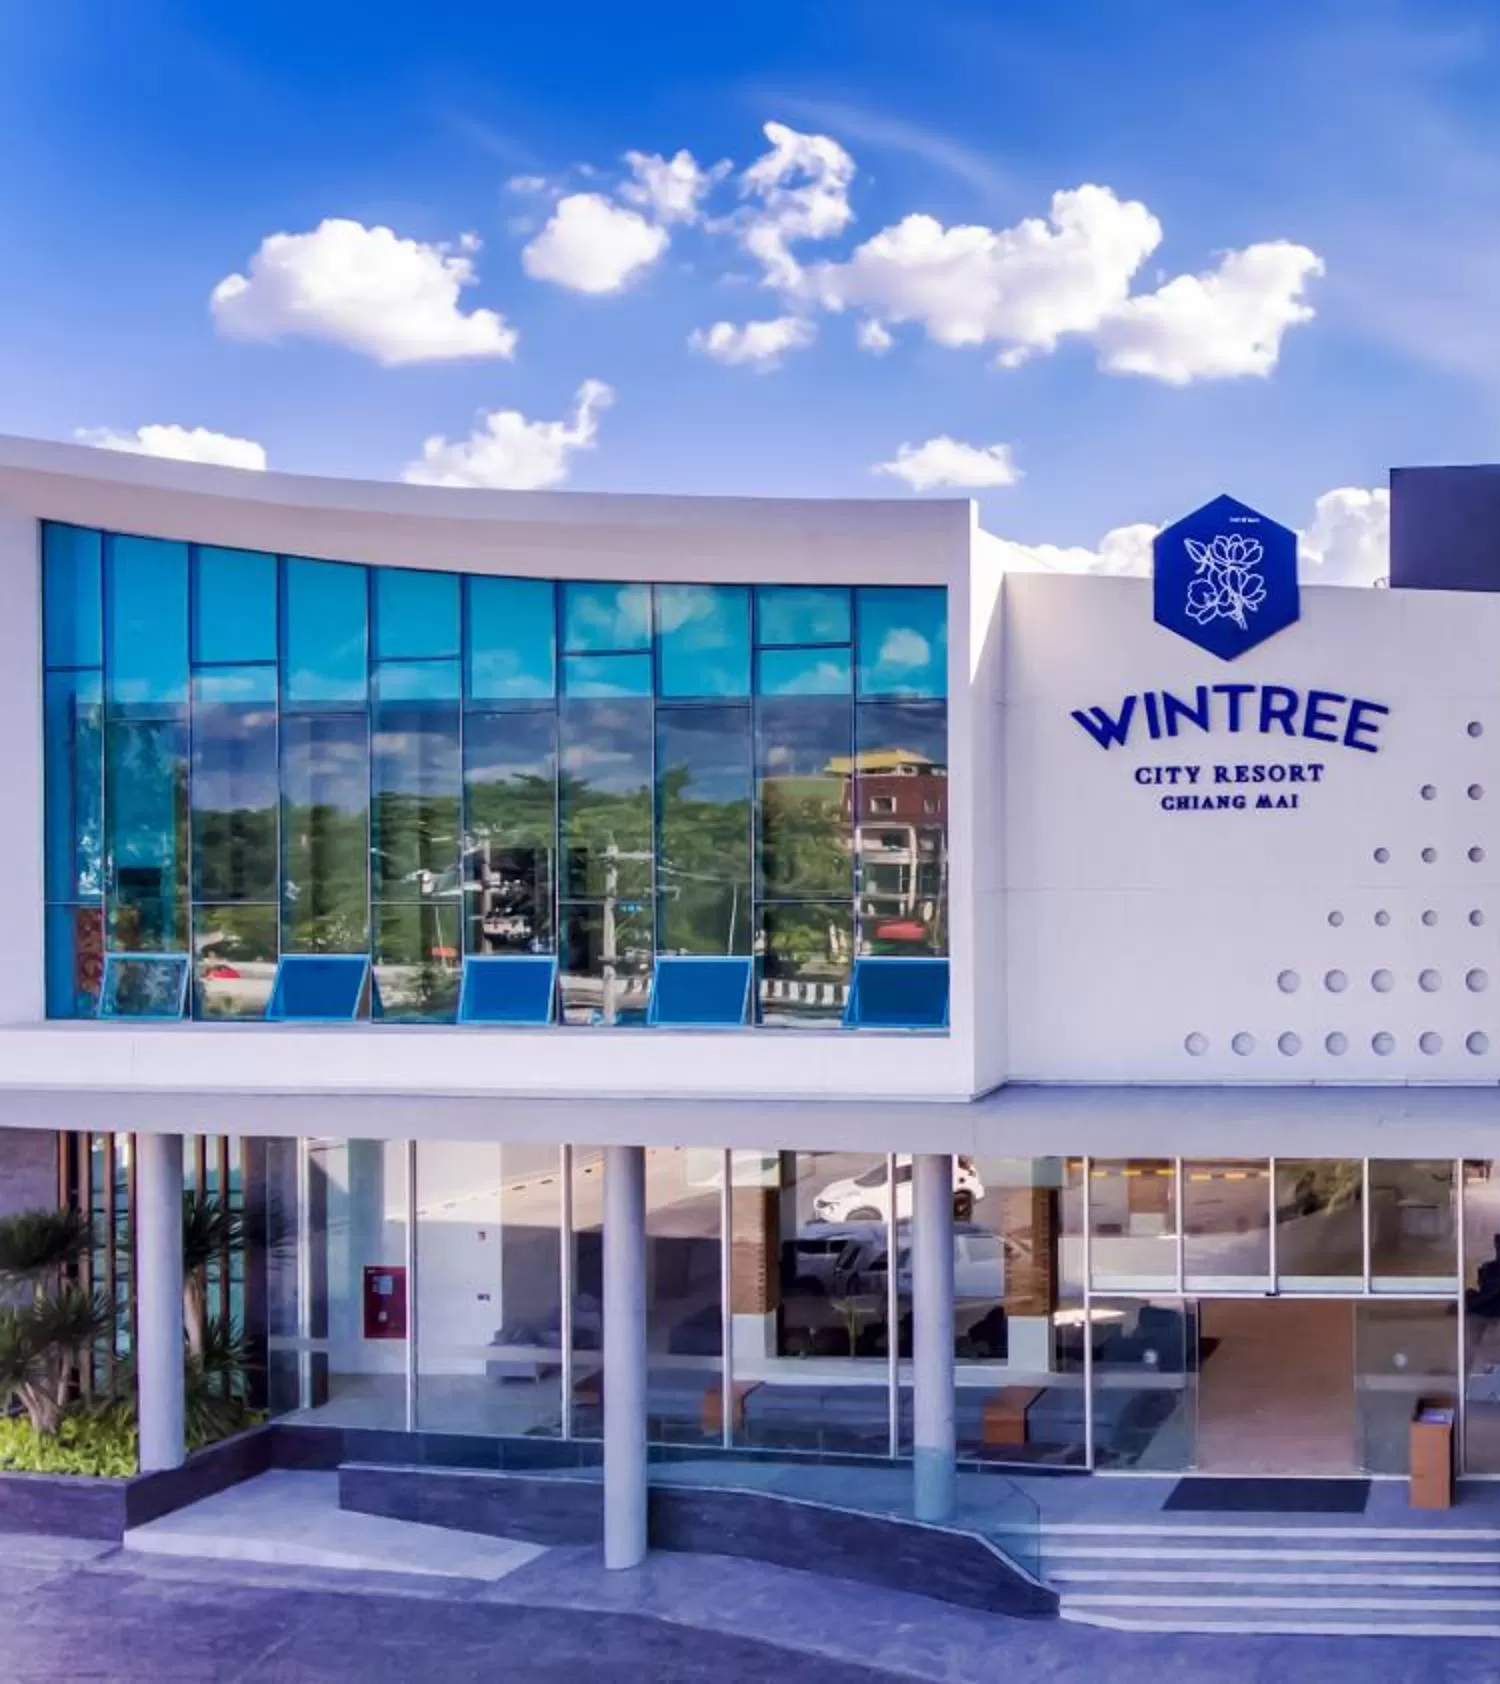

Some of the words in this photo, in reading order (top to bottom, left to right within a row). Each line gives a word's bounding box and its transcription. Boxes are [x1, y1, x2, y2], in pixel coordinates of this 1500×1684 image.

[1070, 683, 1390, 754] WINTREE
[1134, 765, 1201, 785] CITY
[1213, 763, 1325, 784] RESORT
[1160, 794, 1247, 811] CHIANG
[1255, 793, 1299, 809] MAI
